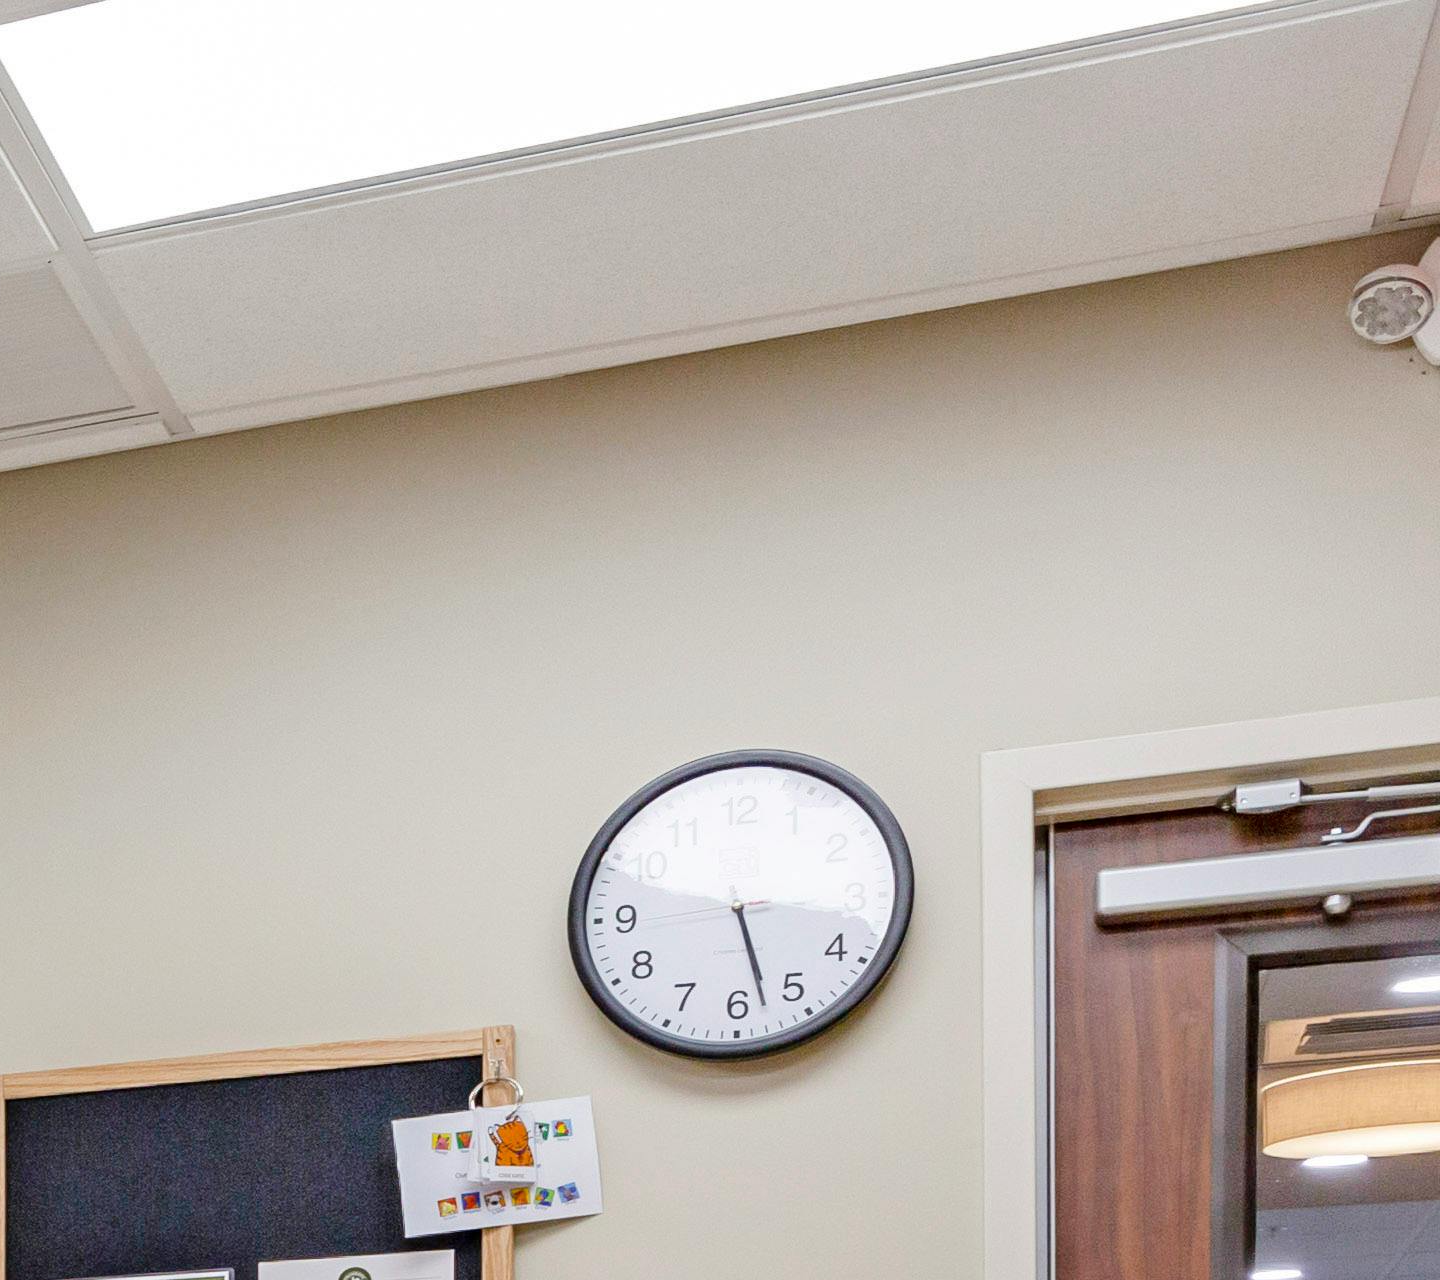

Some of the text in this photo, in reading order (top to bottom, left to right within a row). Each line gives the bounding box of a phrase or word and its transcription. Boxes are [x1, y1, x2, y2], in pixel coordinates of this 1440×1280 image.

[721, 795, 759, 825] 12
[785, 805, 799, 835] 1
[825, 833, 848, 863] 2
[628, 851, 667, 881] 10
[844, 883, 866, 912] 3
[615, 905, 637, 933] 9
[825, 933, 848, 961] 4
[632, 950, 653, 979] 8
[674, 982, 696, 1011] 7
[782, 973, 804, 1001] 5
[727, 991, 748, 1019] 6
